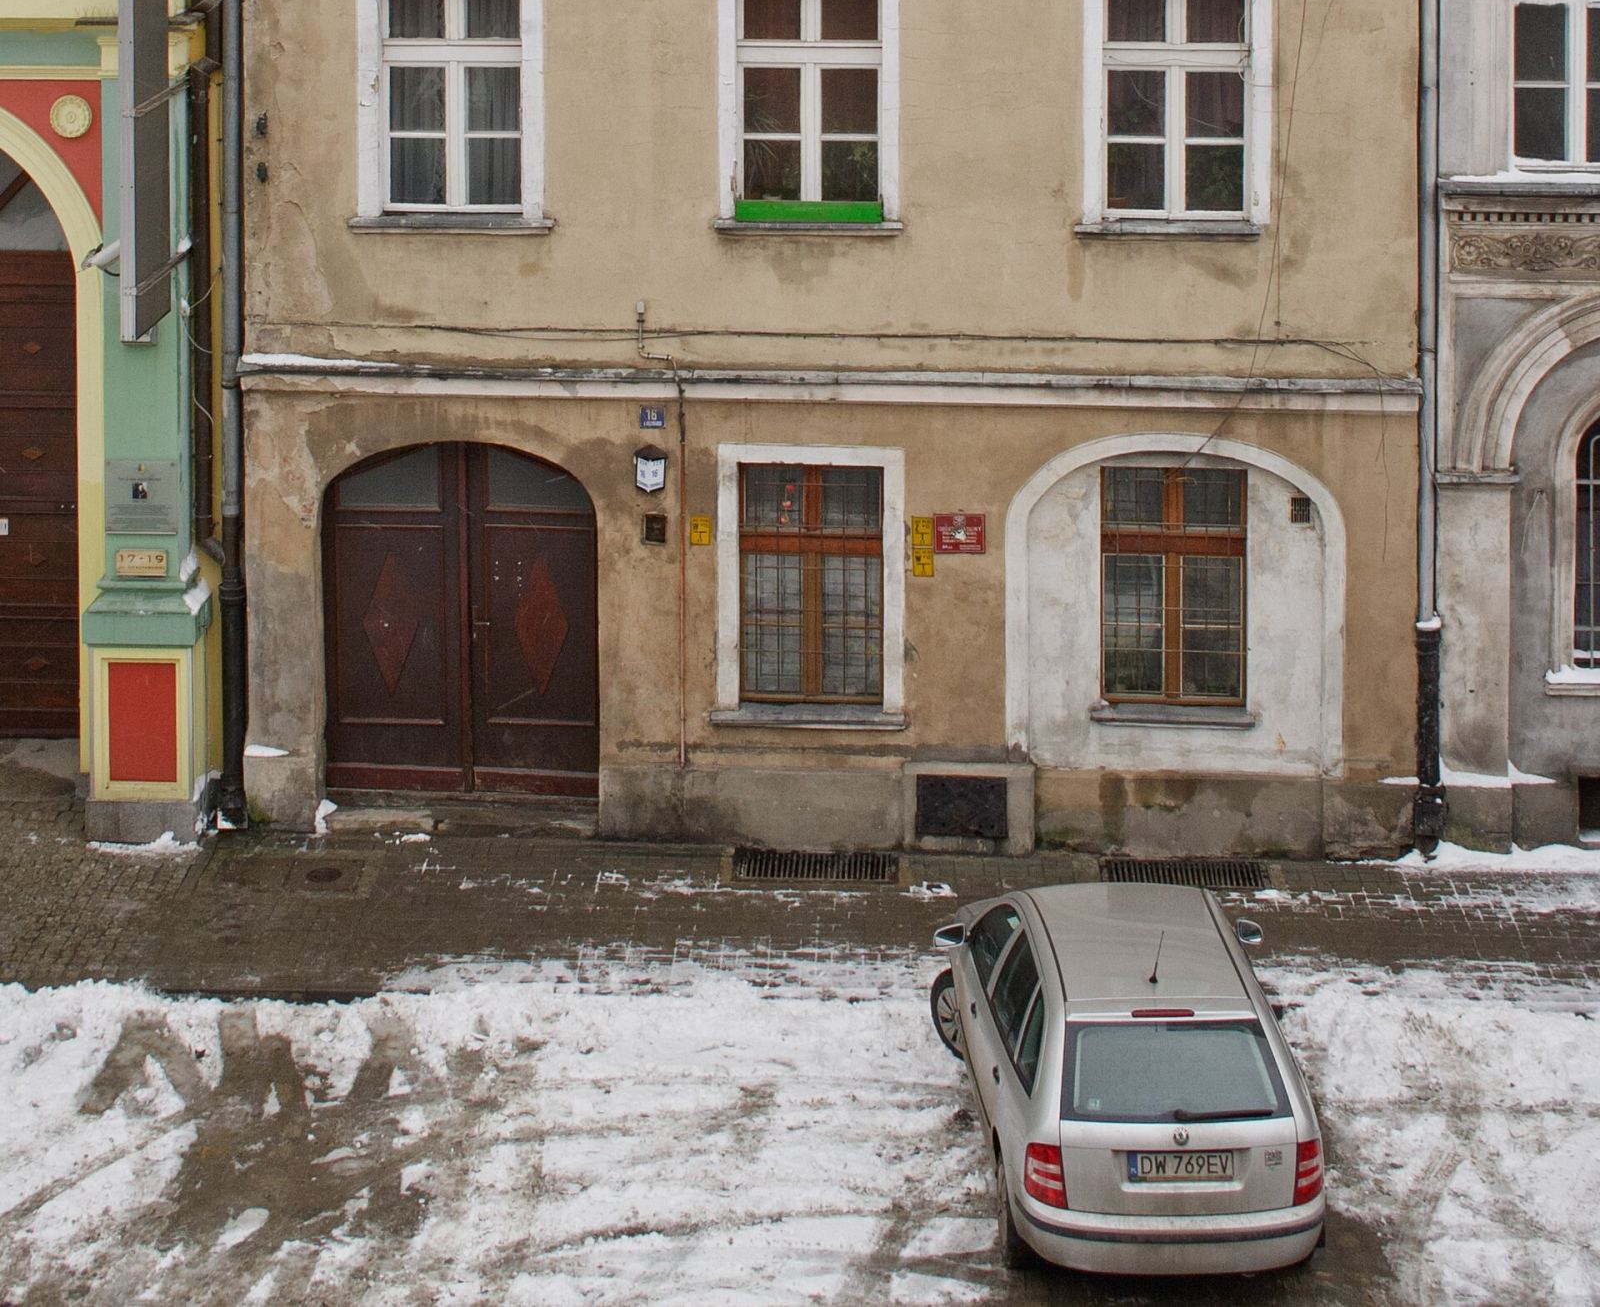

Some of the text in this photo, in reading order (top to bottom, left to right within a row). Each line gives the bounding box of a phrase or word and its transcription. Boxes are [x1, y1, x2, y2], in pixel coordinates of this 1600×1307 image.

[646, 408, 657, 420] 16
[1140, 1154, 1229, 1174] DW 769EV
